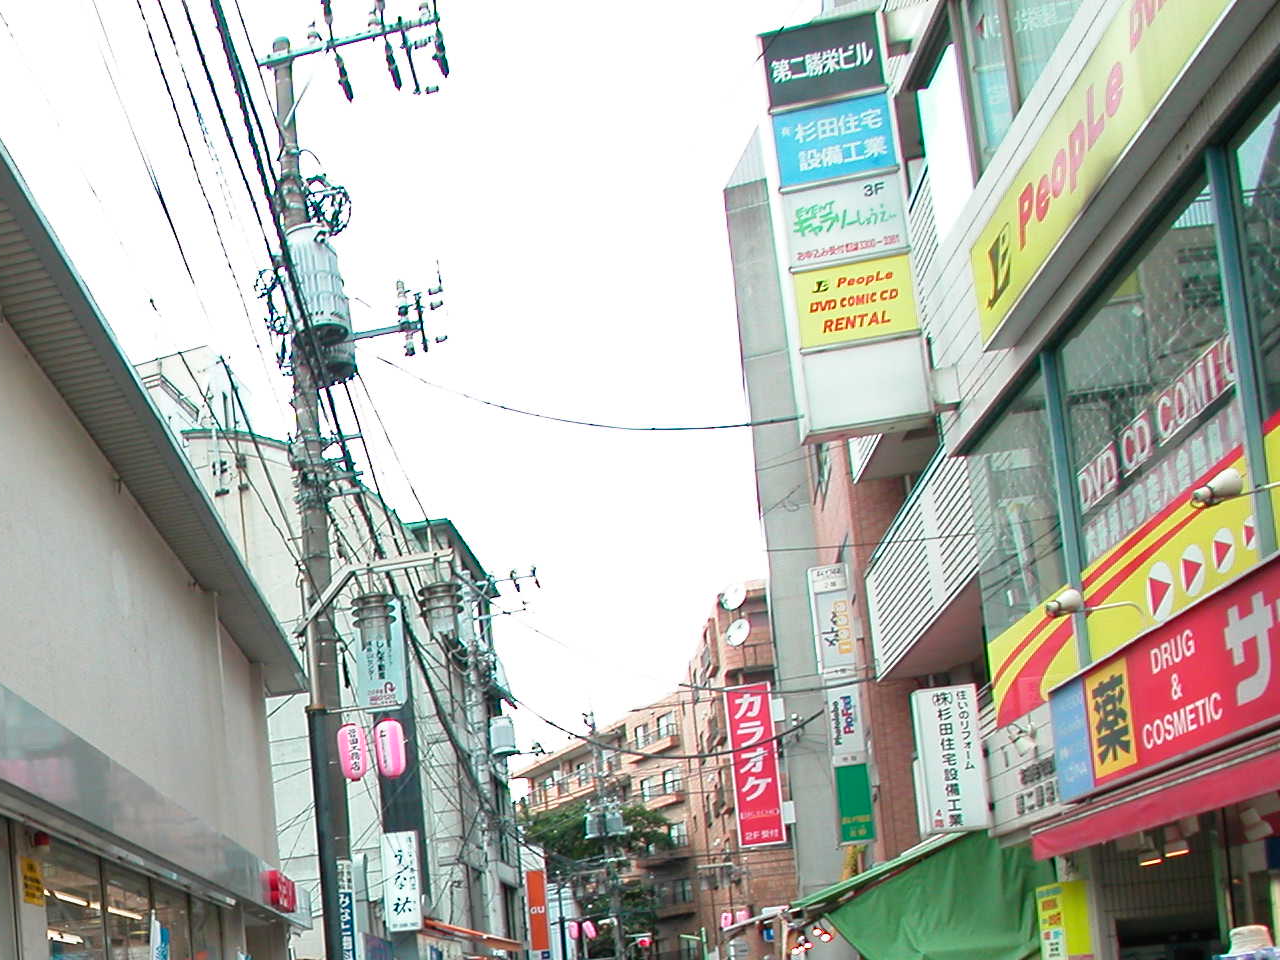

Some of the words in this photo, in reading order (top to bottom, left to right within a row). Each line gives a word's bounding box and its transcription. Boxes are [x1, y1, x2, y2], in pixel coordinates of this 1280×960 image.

[772, 42, 873, 83] 第二勝栄ビル
[794, 107, 883, 143] 杉田住宅
[798, 136, 888, 171] 設備工業
[864, 182, 885, 198] 3F
[809, 299, 837, 313] DVD
[839, 292, 877, 308] COMIC
[879, 288, 899, 300] CD
[823, 310, 891, 333] RENTAL
[1077, 446, 1119, 511] DVD
[1122, 416, 1152, 469] CD
[1150, 629, 1196, 675] DRUG
[1224, 591, 1280, 707] サ
[1171, 673, 1183, 700] &
[956, 690, 976, 770] 住いのリフォーム
[1091, 672, 1132, 766] 薬
[1141, 692, 1224, 750] COSMETIC
[734, 693, 772, 802] カラオケ
[529, 905, 545, 914] au
